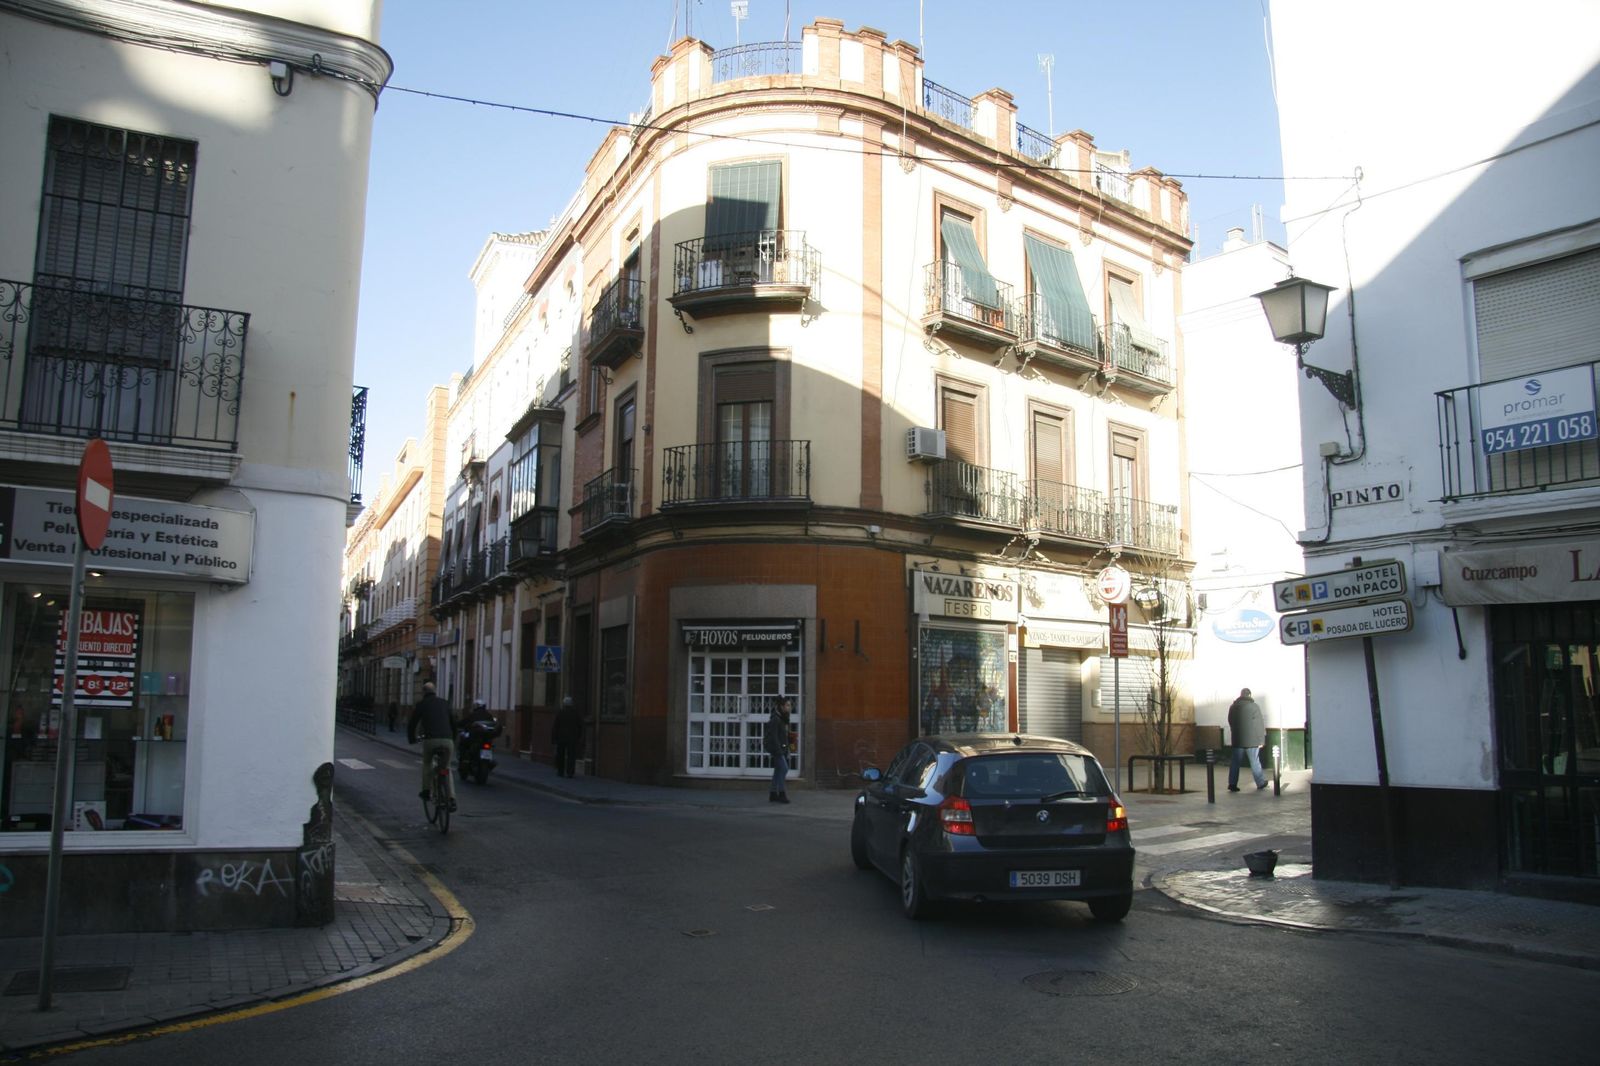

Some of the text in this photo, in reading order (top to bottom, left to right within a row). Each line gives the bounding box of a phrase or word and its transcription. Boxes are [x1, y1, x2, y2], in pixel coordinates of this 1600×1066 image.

[1503, 391, 1565, 416] promar
[1485, 430, 1515, 452] 954
[1520, 422, 1550, 446] 221
[1557, 415, 1592, 440] 058
[1332, 483, 1401, 507] PINTO
[112, 509, 219, 531] especializada
[140, 532, 150, 544] y
[155, 531, 219, 549] Estética
[14, 538, 66, 553] Venta
[171, 554, 180, 566] y
[184, 553, 238, 571] Público
[1462, 564, 1538, 582] Cruzcampo
[1569, 549, 1600, 582] L
[1356, 568, 1397, 582] HOTEL
[923, 575, 1013, 602] NAZARENOS
[1334, 584, 1360, 598] DON
[1363, 579, 1398, 593] PACO
[945, 601, 991, 617] TESPIS
[1373, 605, 1406, 617] HOTEL
[63, 609, 134, 636] RBAJAS
[1326, 623, 1358, 635] POSADA
[1359, 621, 1374, 631] DEL
[1375, 617, 1407, 628] LUCERO
[699, 630, 792, 645] HOYOS PELUQUEROS
[103, 642, 131, 653] DIRECTO
[1021, 871, 1077, 885] 5039 DSH
